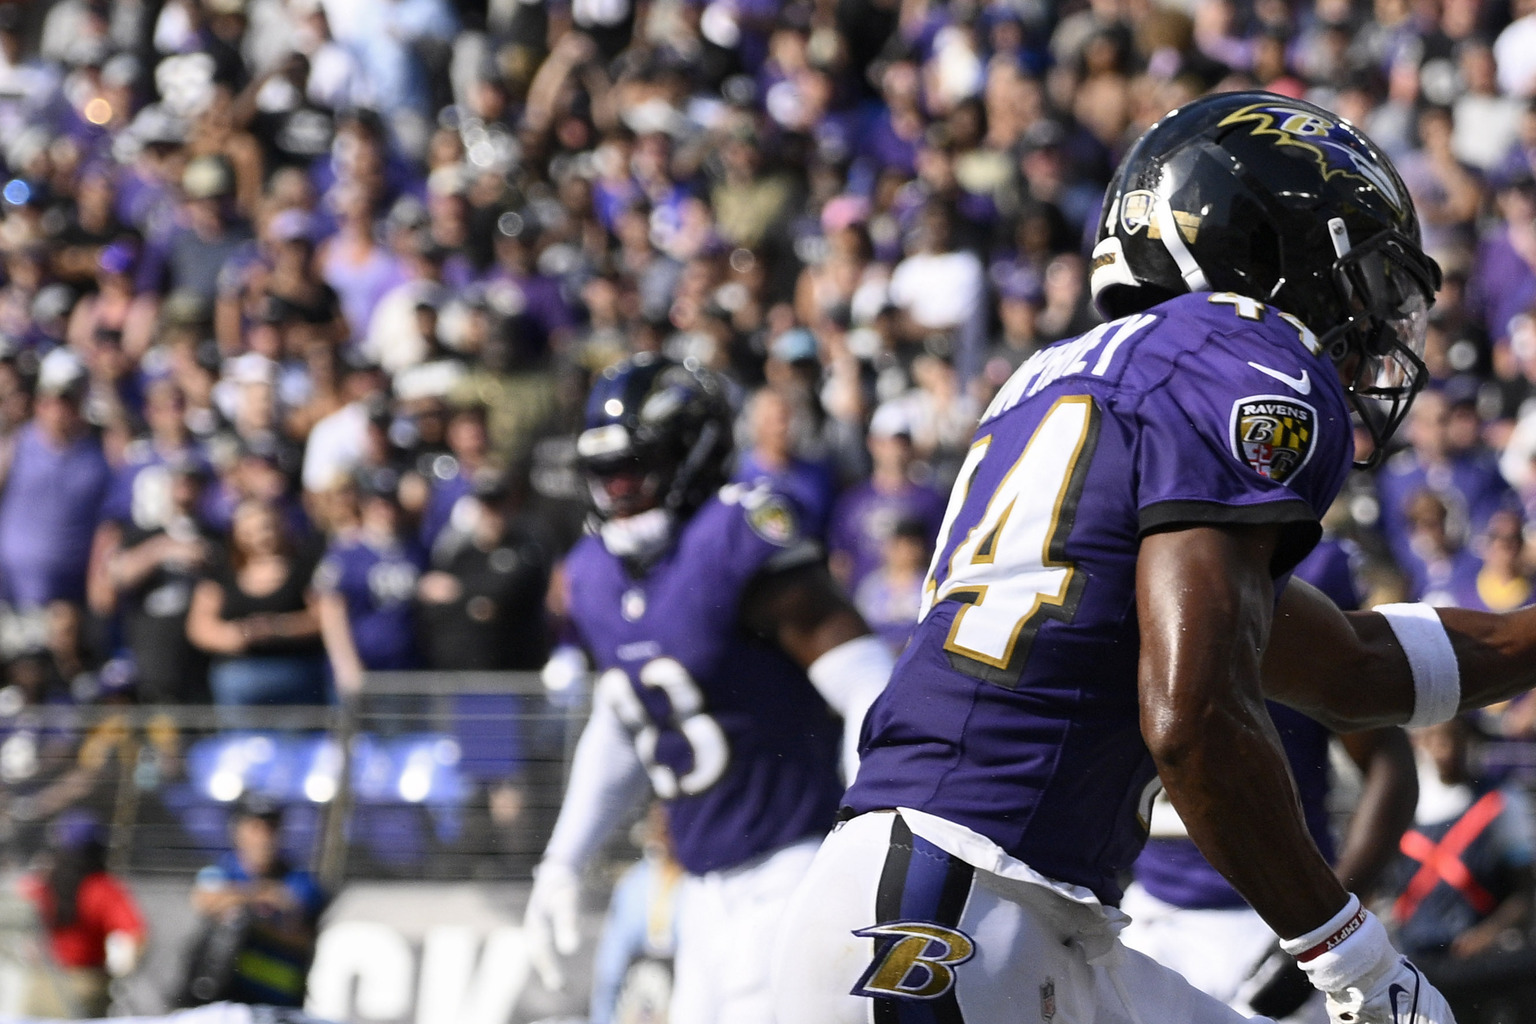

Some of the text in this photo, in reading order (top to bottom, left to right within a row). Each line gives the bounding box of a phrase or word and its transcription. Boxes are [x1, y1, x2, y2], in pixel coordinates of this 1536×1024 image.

[1242, 404, 1308, 421] RAVENS
[1326, 920, 1361, 950] EMPTY
[850, 919, 976, 1000] B
